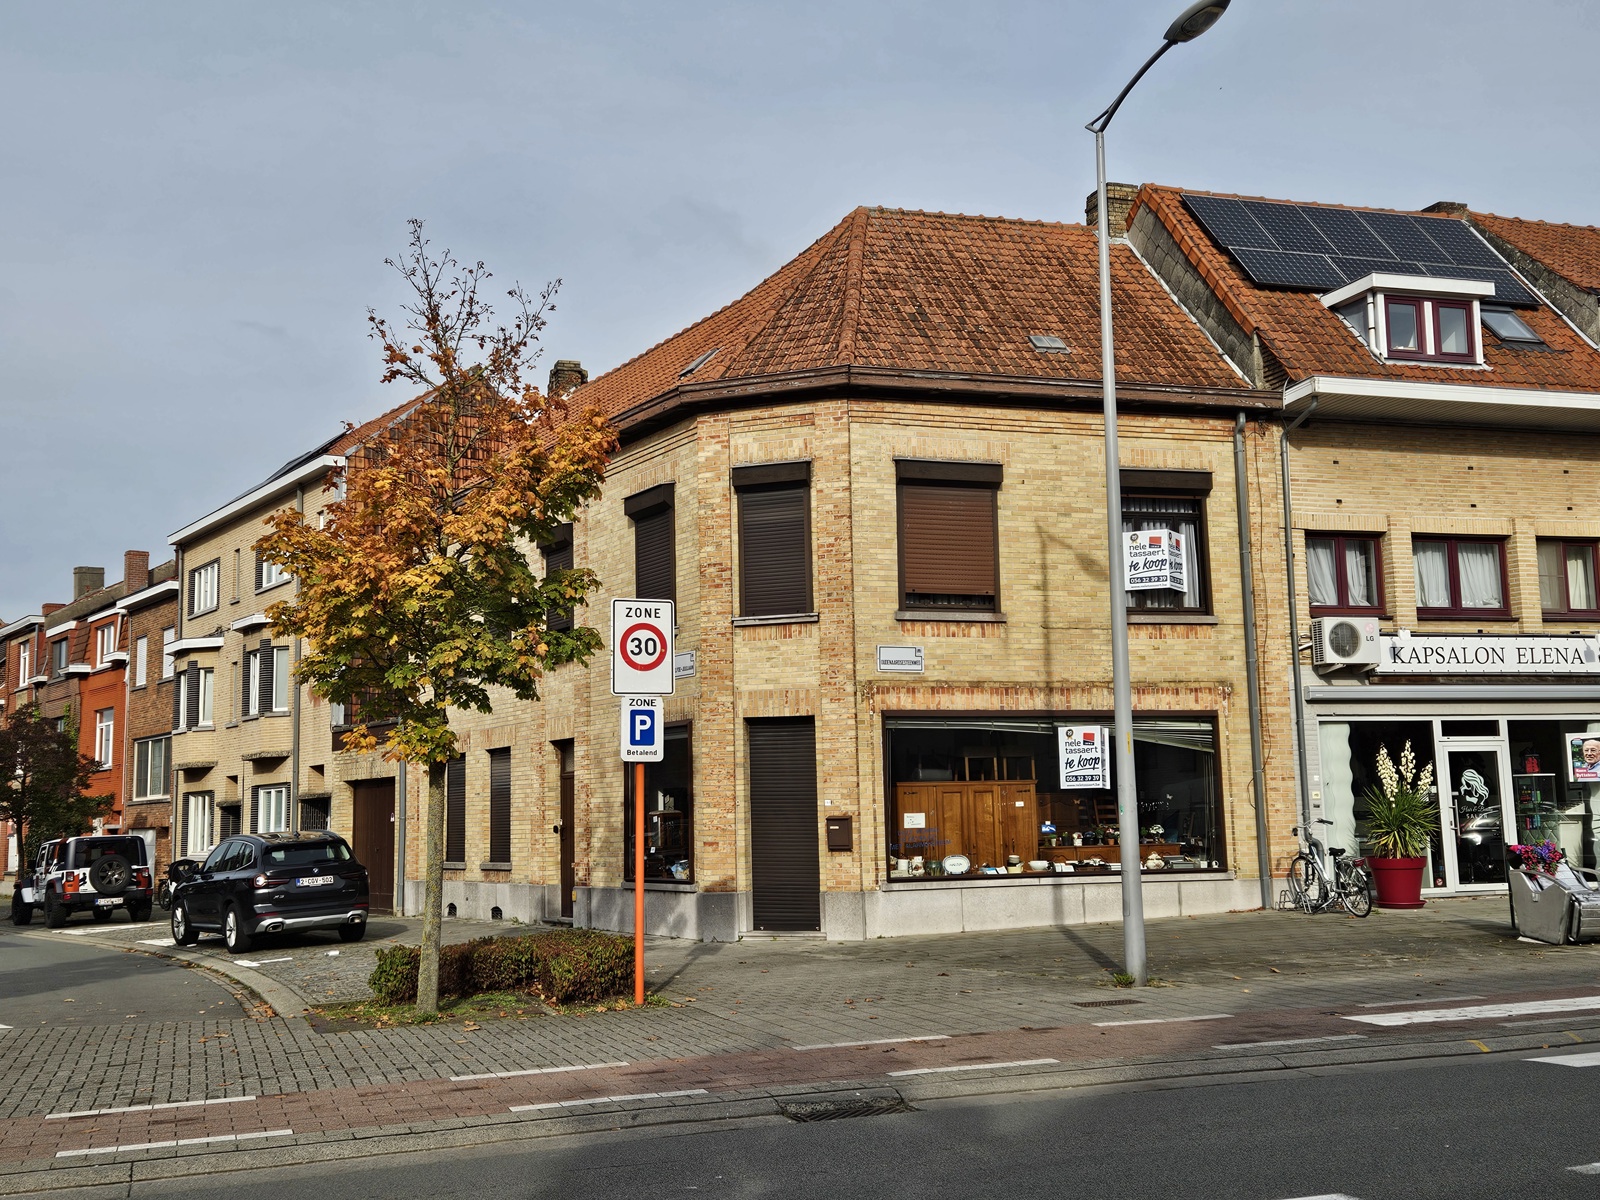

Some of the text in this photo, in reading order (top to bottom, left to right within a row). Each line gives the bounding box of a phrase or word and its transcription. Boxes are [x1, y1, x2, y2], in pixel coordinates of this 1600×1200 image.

[1129, 543, 1147, 551] nele
[1129, 548, 1166, 558] tassaert
[1129, 557, 1167, 572] te koop
[625, 607, 661, 619] ZONE
[630, 637, 657, 656] 30
[1391, 646, 1586, 665] KAPSALON ELENA
[629, 698, 657, 707] ZONE
[635, 715, 652, 741] P
[1065, 739, 1081, 747] nele
[1065, 746, 1098, 755] tassaert
[1065, 755, 1100, 770] te koop
